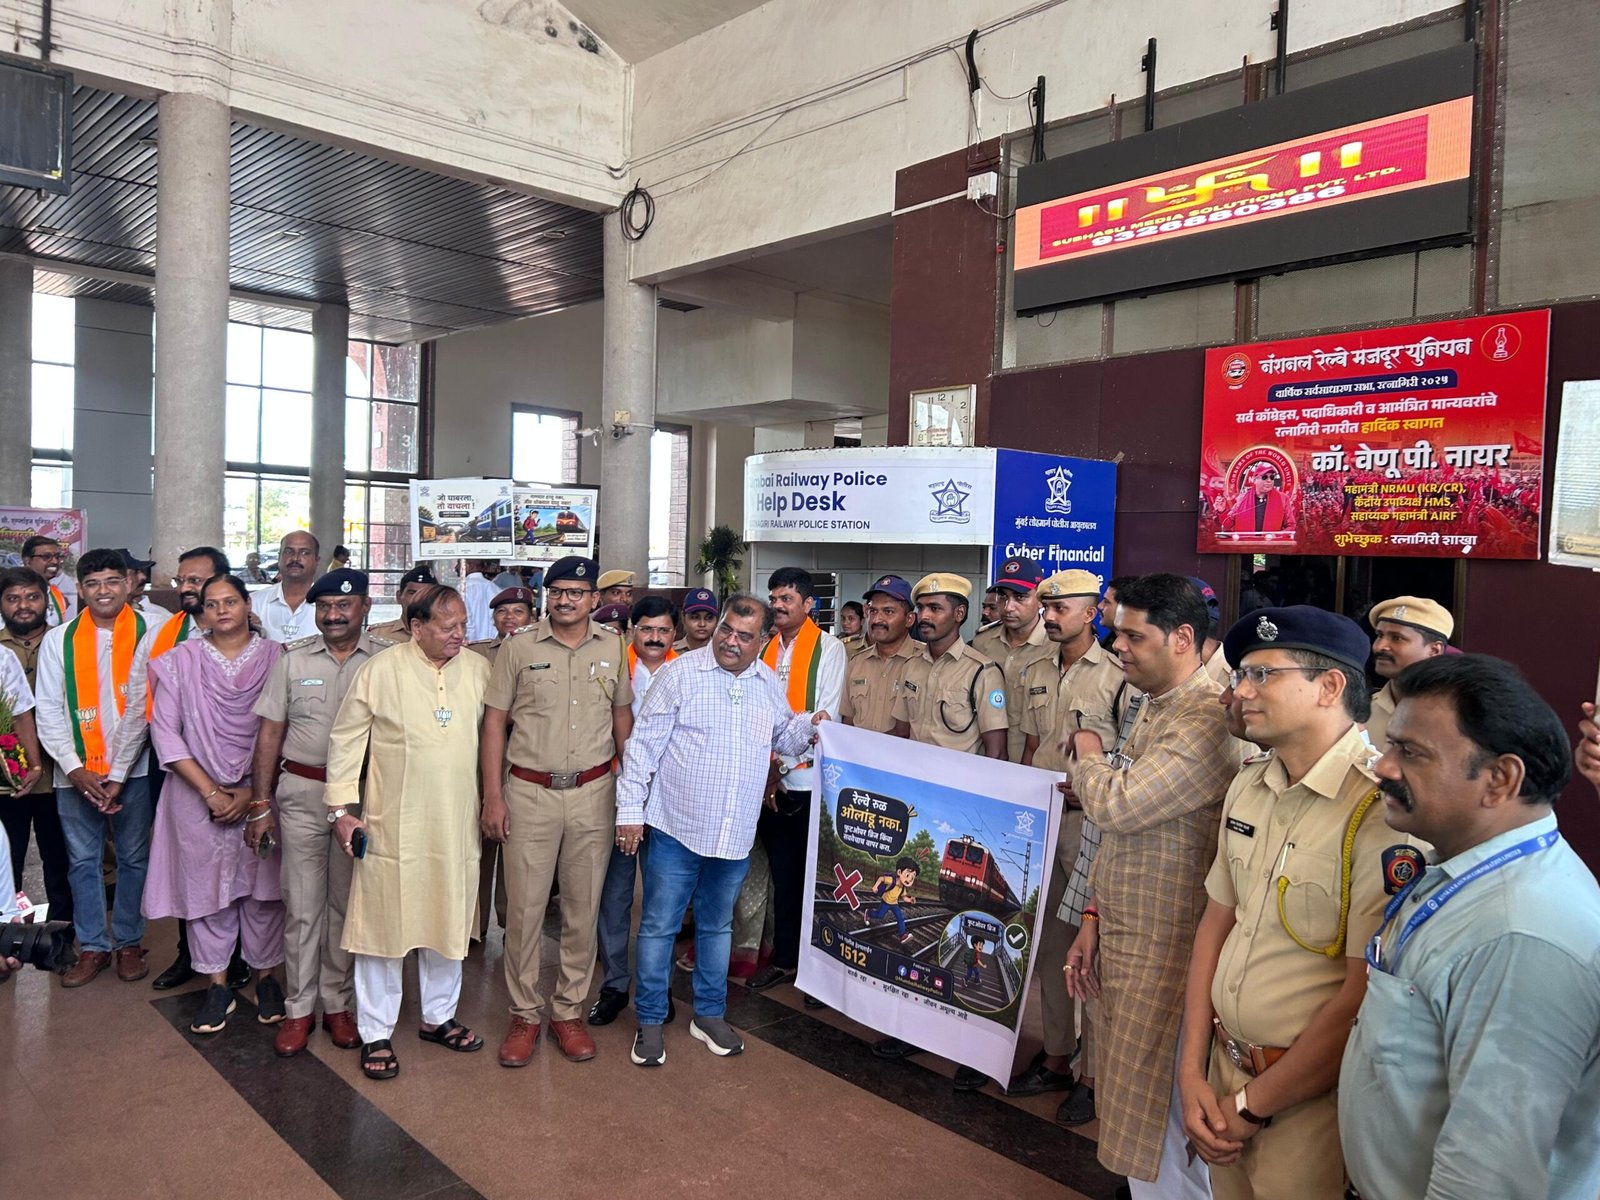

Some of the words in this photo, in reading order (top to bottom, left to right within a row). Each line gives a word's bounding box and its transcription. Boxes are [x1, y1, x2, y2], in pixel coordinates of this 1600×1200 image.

[1052, 226, 1126, 247] SUBHASU
[1130, 213, 1184, 230] MEDIA
[1188, 188, 1297, 217] SOLUTIONS
[1303, 177, 1347, 192] PVT.
[1353, 166, 1402, 182] LTD.
[1313, 347, 1350, 371] रेल्वे
[1351, 345, 1404, 370] मजदूर
[1404, 336, 1473, 366] युनियन
[1275, 385, 1302, 398] वार्षिक
[1304, 382, 1353, 396] सर्वसाधारण
[1353, 381, 1376, 392] सभा,
[1421, 375, 1449, 386] २०२५
[1235, 409, 1254, 424] सर्व
[1302, 401, 1364, 419] पदाधिकारी
[1365, 403, 1376, 414] व
[1378, 397, 1430, 413] आमंत्रित
[1431, 391, 1498, 410] मान्यवरांचे
[1275, 421, 1320, 437] रत्नागिरी
[1321, 420, 1360, 434] नगरीत
[1361, 417, 1400, 433] हार्दिक
[1402, 417, 1445, 430] स्वागत
[1311, 444, 1349, 472] कॉ.
[1355, 443, 1401, 478] वेणू
[1403, 440, 1438, 469] पी.
[1444, 444, 1511, 468] नायर
[776, 471, 830, 490] Railway
[833, 470, 888, 486] Police
[1344, 482, 1378, 494] महामंत्री
[1380, 483, 1416, 493] NRMU
[1417, 482, 1467, 495] (KR/CR),
[757, 491, 788, 517] Help
[792, 491, 847, 511] Desk
[1354, 496, 1381, 507] केंद्रीय
[1383, 496, 1422, 507] उपाध्यक्ष
[1424, 497, 1454, 508] HMS,
[771, 520, 798, 529] RAILWAY
[799, 520, 829, 529] POLICE
[830, 520, 870, 530] STATION
[1351, 511, 1390, 521] सहाय्यक
[1392, 510, 1428, 521] महामंत्री
[1430, 511, 1457, 521] AIRF
[1334, 531, 1382, 548] शुभेच्छुक
[1391, 532, 1439, 545] रत्नागिरी
[1048, 544, 1105, 562] Financial
[852, 791, 871, 807] रेल्वे
[872, 798, 888, 811] रुळ
[841, 804, 877, 829] ओलांडू
[878, 815, 903, 832] नका.
[839, 943, 867, 967] 1512
